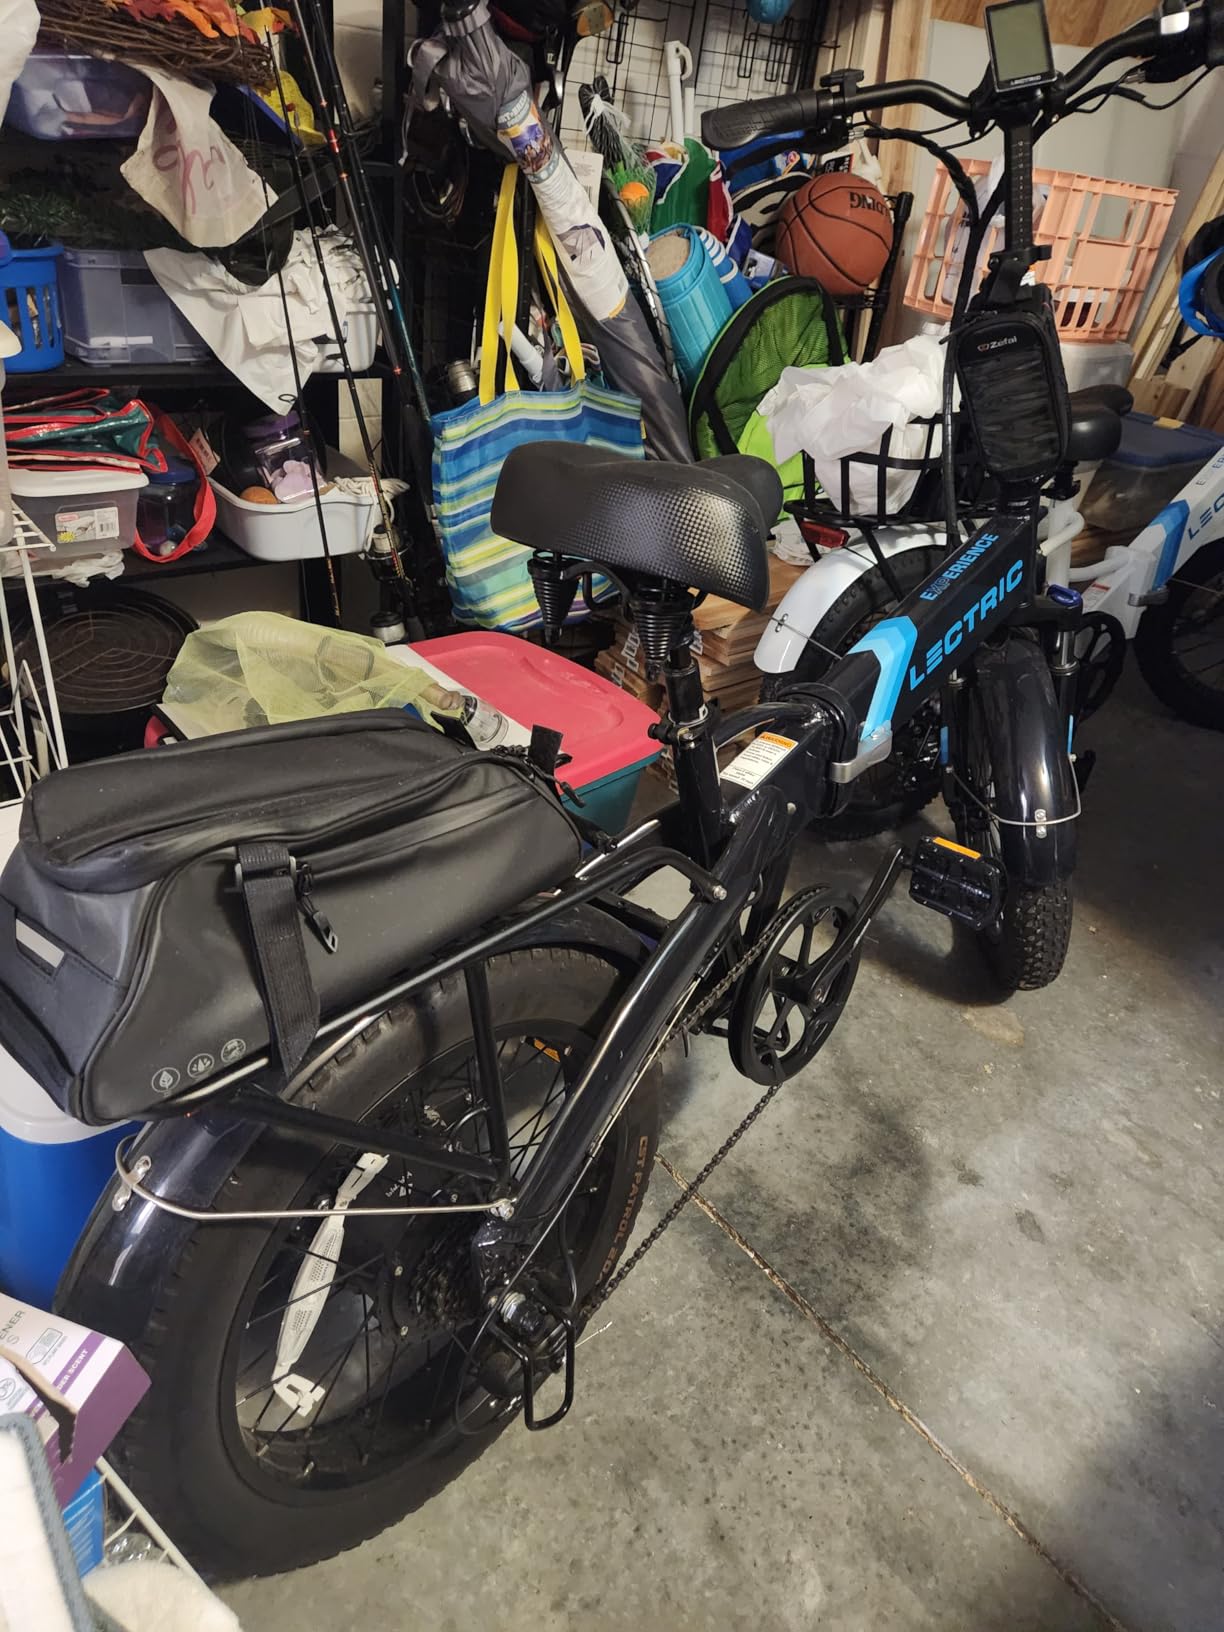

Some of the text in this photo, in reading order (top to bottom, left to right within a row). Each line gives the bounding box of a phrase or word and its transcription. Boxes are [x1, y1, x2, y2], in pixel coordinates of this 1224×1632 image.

[920, 532, 999, 601] EXPERIENCE
[909, 559, 1024, 691] LECTRIC
[614, 1171, 643, 1244] PATROL
[68, 1349, 88, 1374] SCENT
